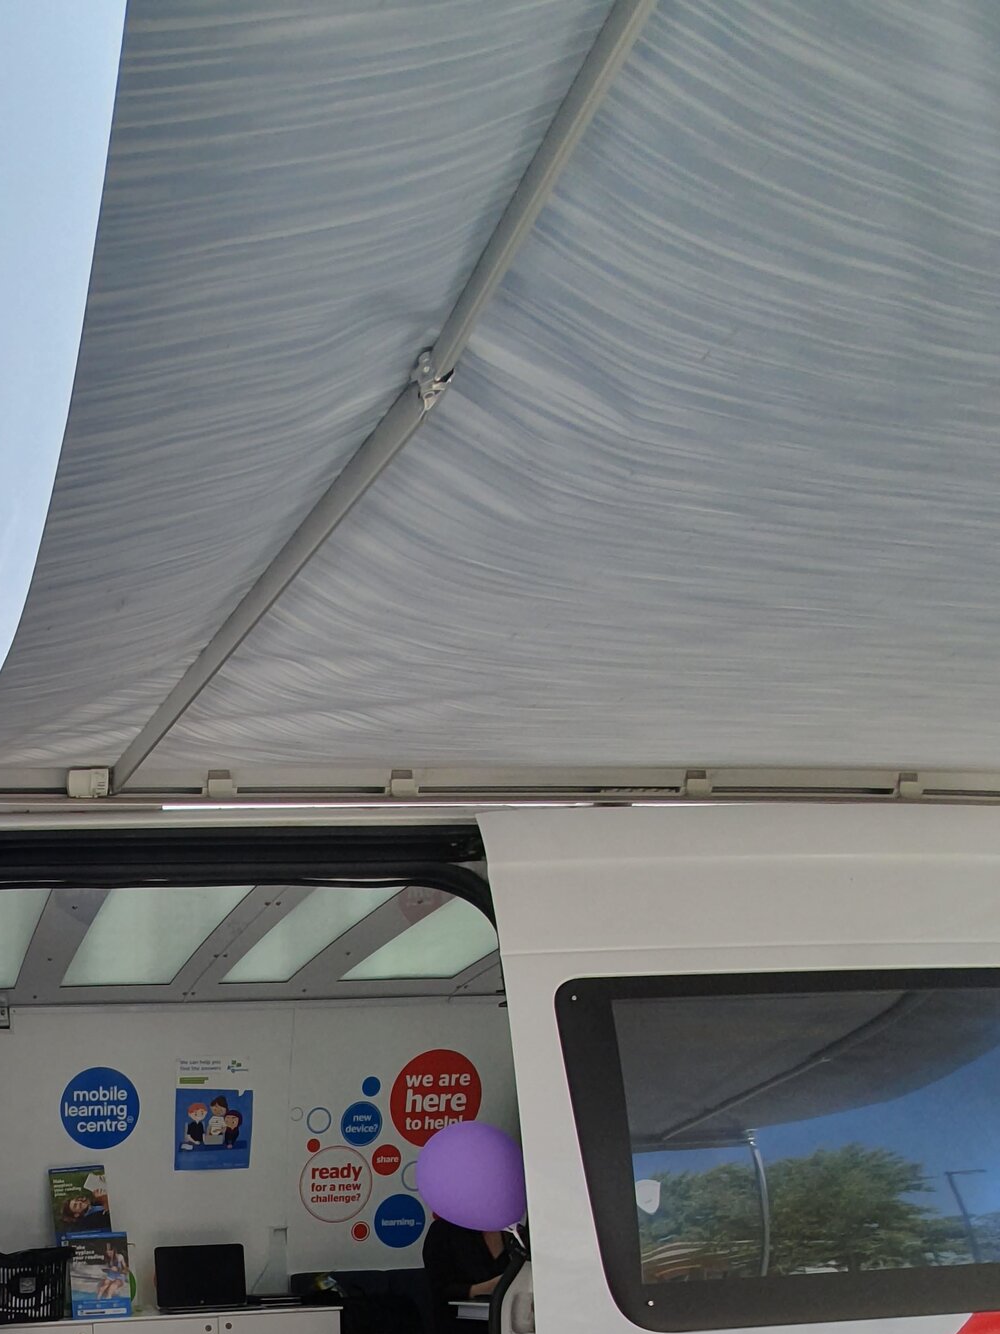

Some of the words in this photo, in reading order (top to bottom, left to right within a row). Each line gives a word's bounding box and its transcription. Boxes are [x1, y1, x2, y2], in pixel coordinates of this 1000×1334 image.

[405, 1074, 433, 1087] we
[439, 1073, 471, 1087] are
[73, 1086, 128, 1102] mobile
[405, 1089, 467, 1113] here
[64, 1102, 128, 1120] learning
[353, 1114, 372, 1122] new
[405, 1117, 422, 1130] to
[77, 1118, 128, 1133] centre
[345, 1123, 378, 1133] device?
[376, 1155, 399, 1164] share
[311, 1163, 363, 1182] ready
[311, 1183, 327, 1192] for
[338, 1183, 361, 1191] new
[311, 1193, 361, 1204] challenge?
